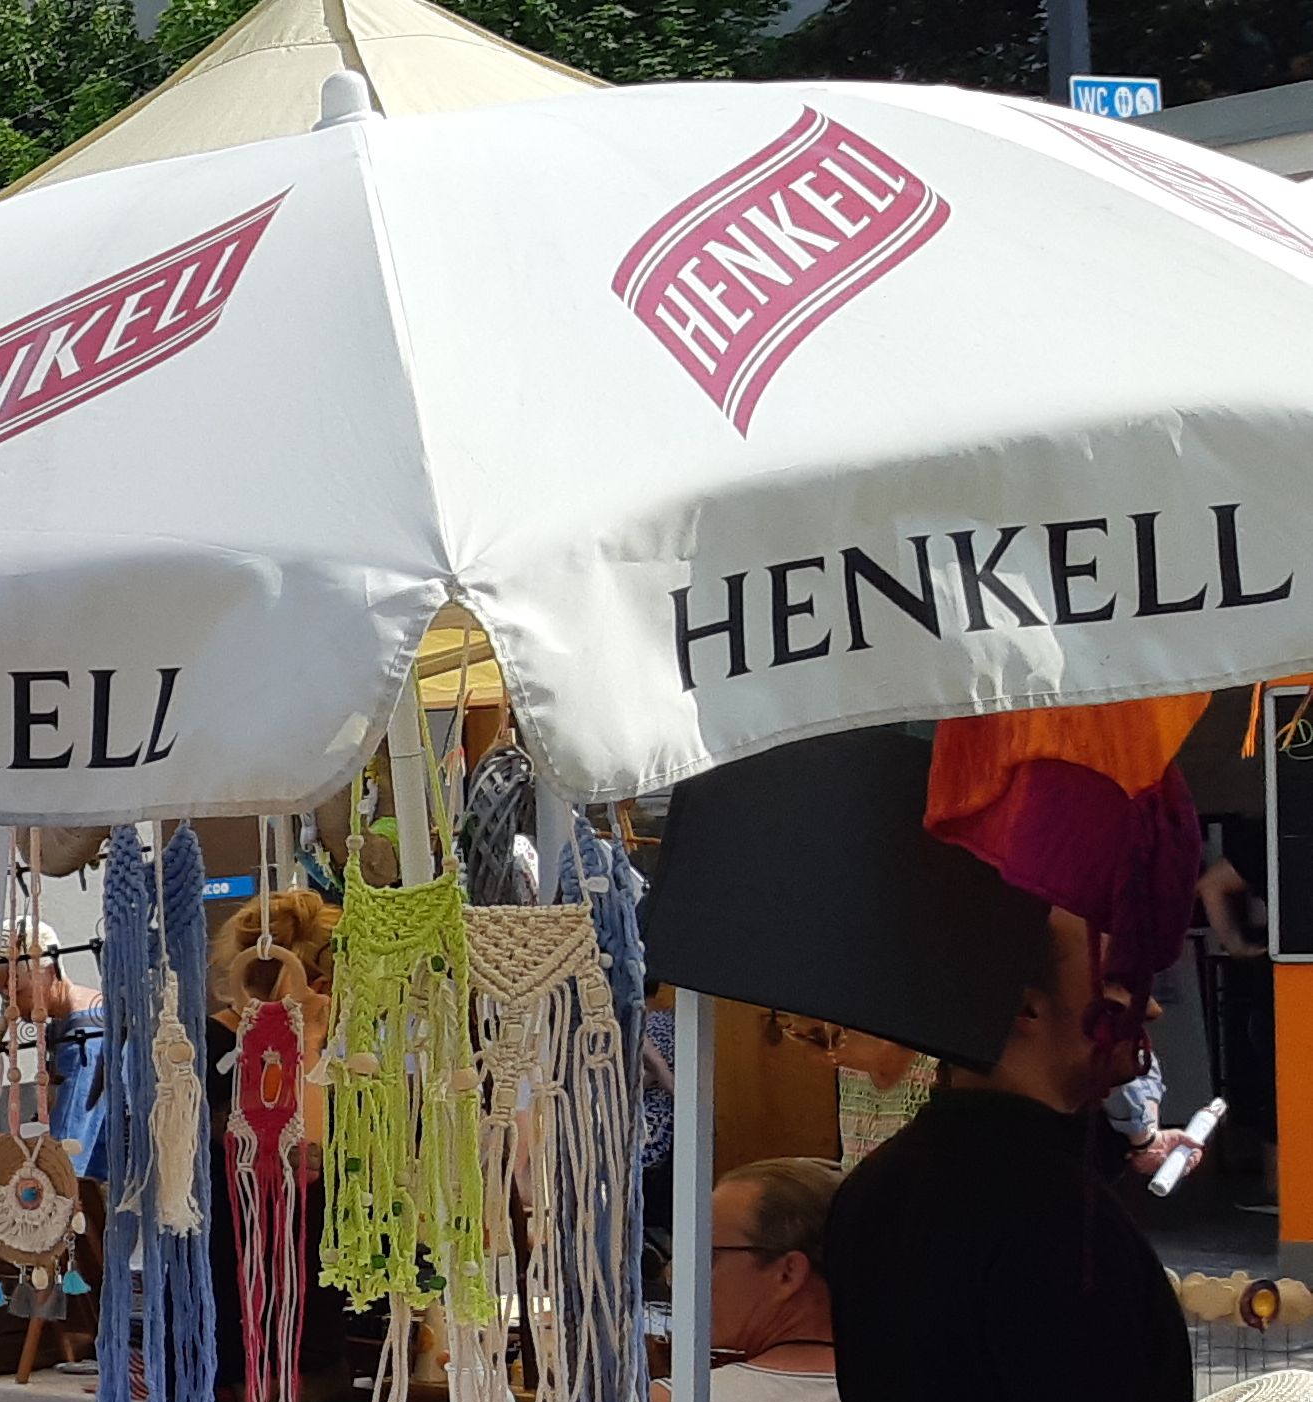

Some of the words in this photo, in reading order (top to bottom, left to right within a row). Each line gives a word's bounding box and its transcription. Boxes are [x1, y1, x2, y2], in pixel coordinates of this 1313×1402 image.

[1077, 86, 1110, 115] WC
[655, 140, 908, 376] HENKELL
[667, 502, 1295, 693] HENKELL
